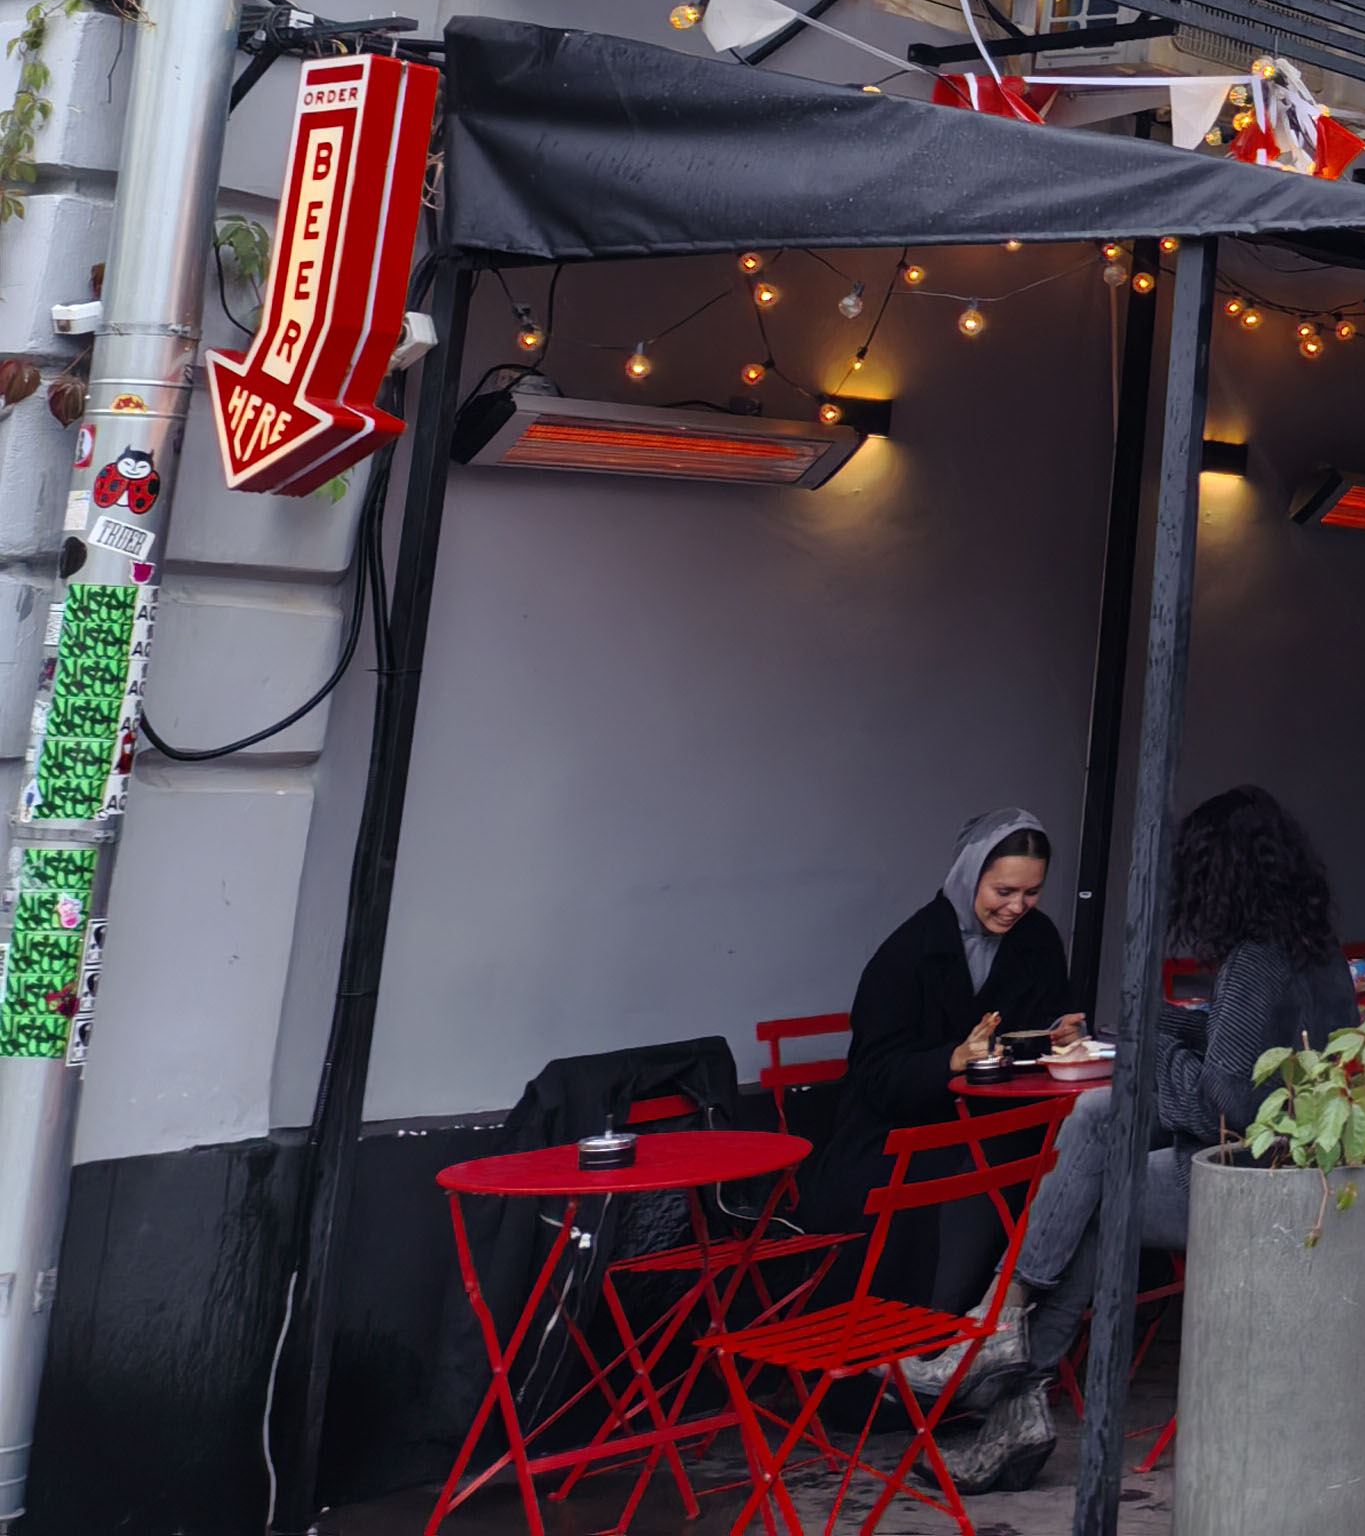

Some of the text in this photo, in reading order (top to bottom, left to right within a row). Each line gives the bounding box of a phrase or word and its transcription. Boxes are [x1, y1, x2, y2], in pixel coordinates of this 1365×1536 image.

[303, 86, 359, 106] ORDER
[275, 141, 333, 363] BEER
[227, 386, 293, 462] HERE
